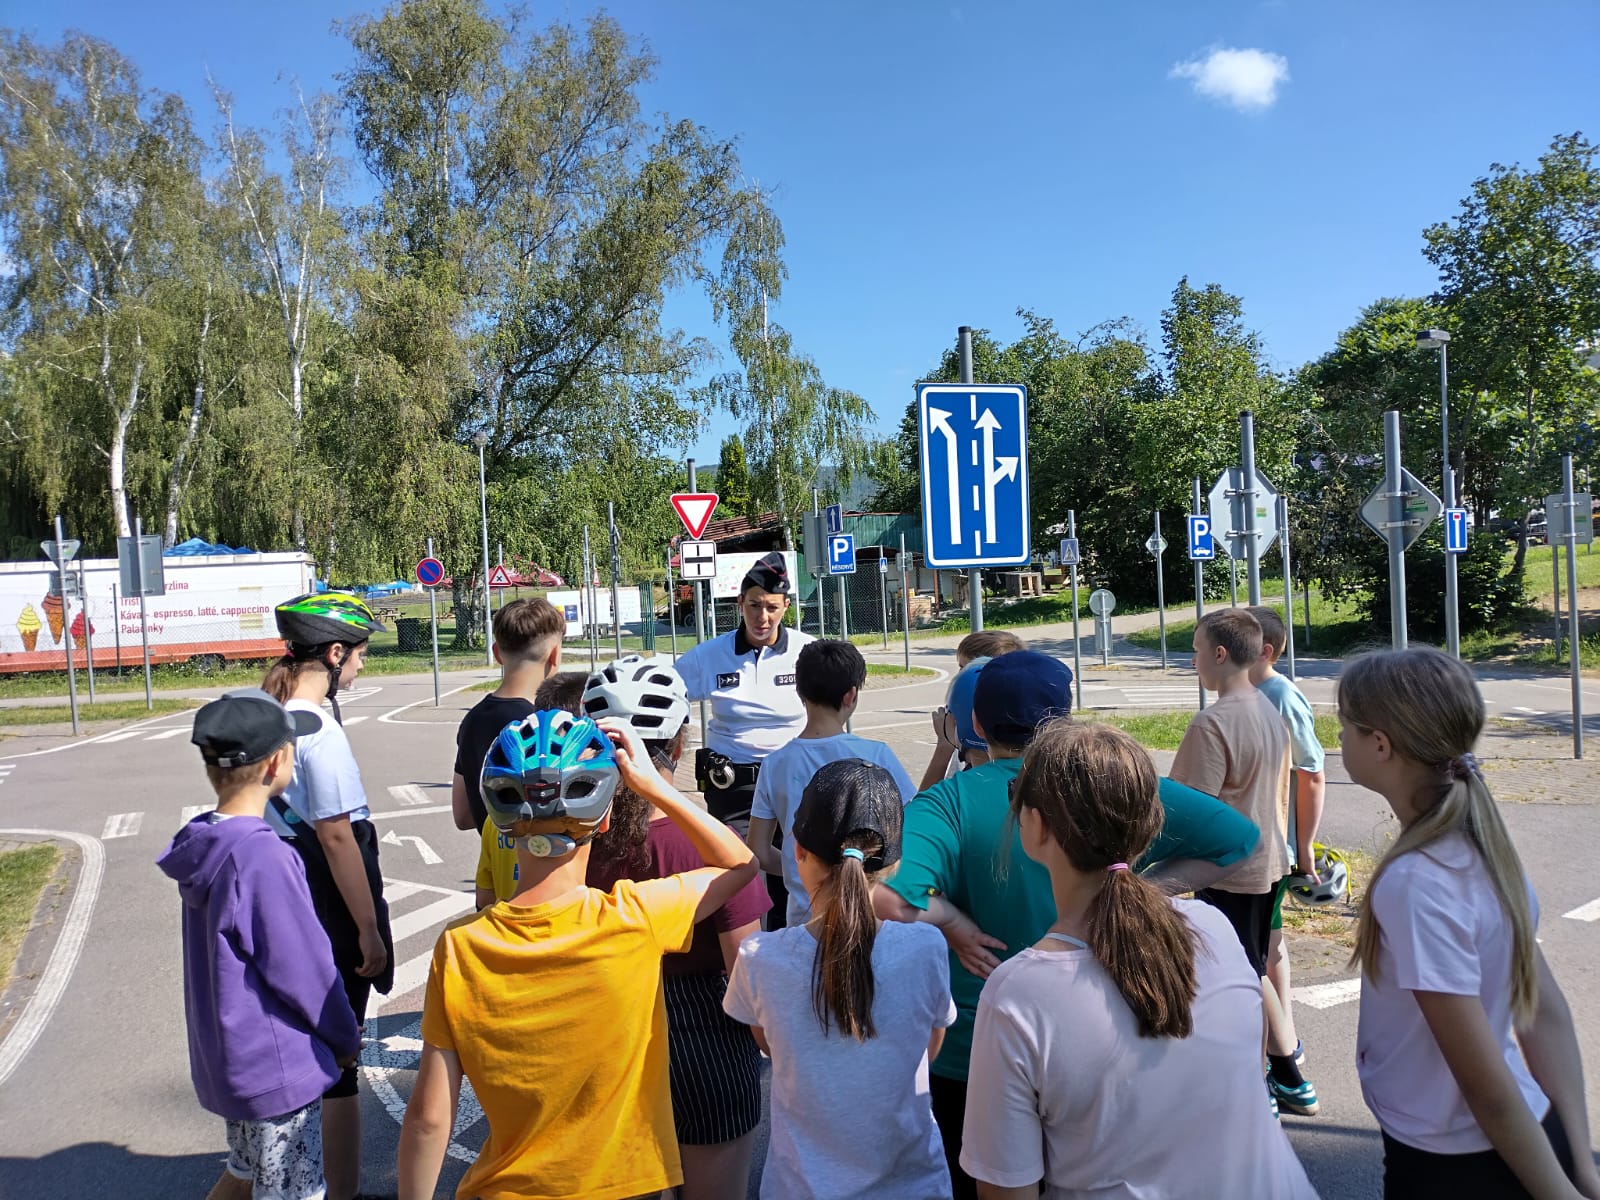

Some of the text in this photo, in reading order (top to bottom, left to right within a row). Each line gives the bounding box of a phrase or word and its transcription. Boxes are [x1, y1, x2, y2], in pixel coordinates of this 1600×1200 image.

[1194, 519, 1209, 546] P
[834, 538, 849, 562] P
[164, 581, 189, 591] rzlina
[221, 605, 270, 617] cappuccino
[778, 675, 796, 684] 320
